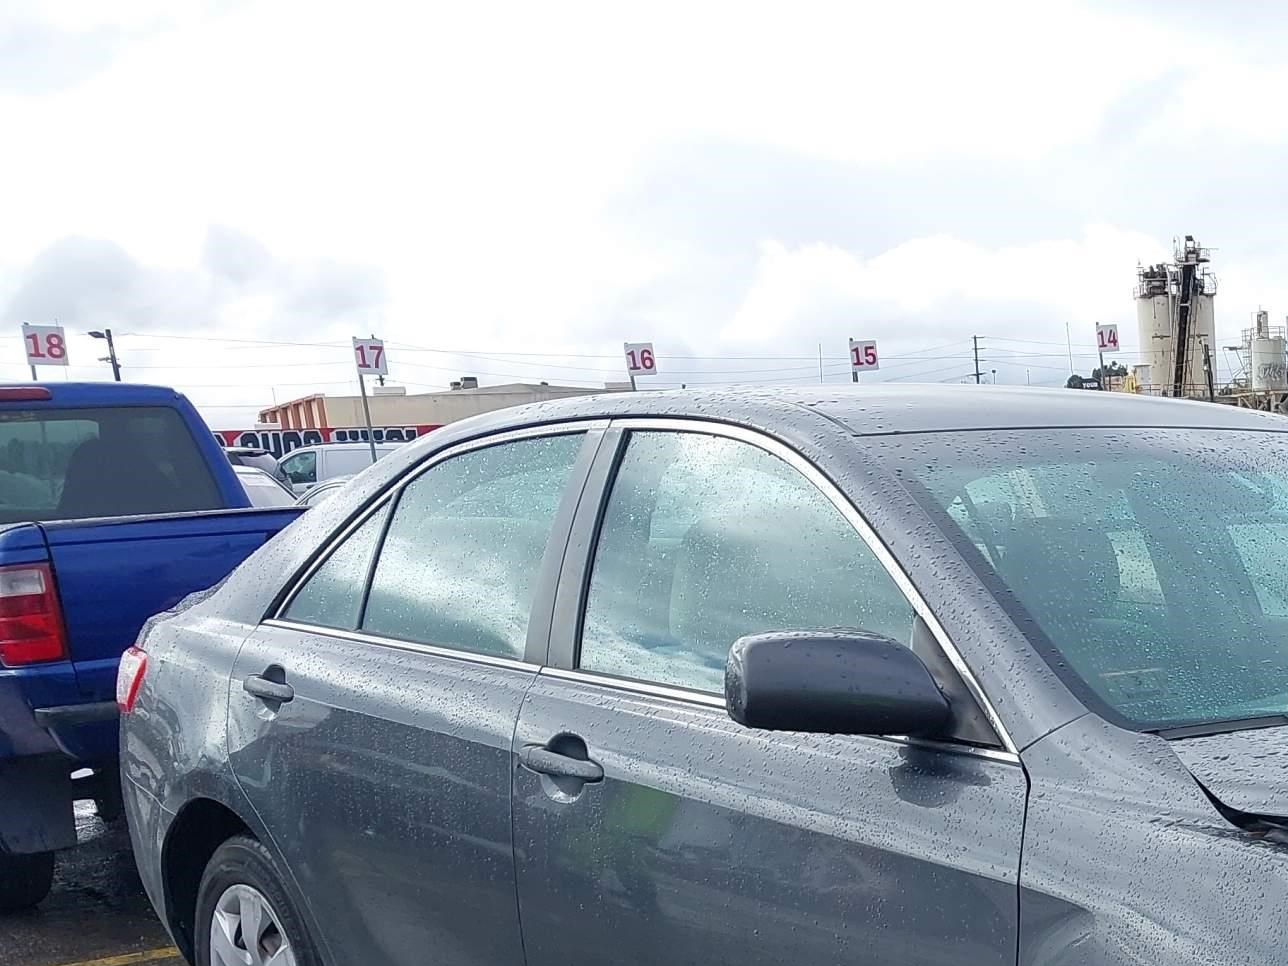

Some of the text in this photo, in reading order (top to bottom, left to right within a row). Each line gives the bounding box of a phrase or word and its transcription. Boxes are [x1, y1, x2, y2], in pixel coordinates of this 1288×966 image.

[26, 333, 66, 359] 18
[1097, 329, 1118, 349] 14
[355, 344, 384, 369] 17
[627, 349, 654, 371] 16
[851, 345, 877, 366] 15
